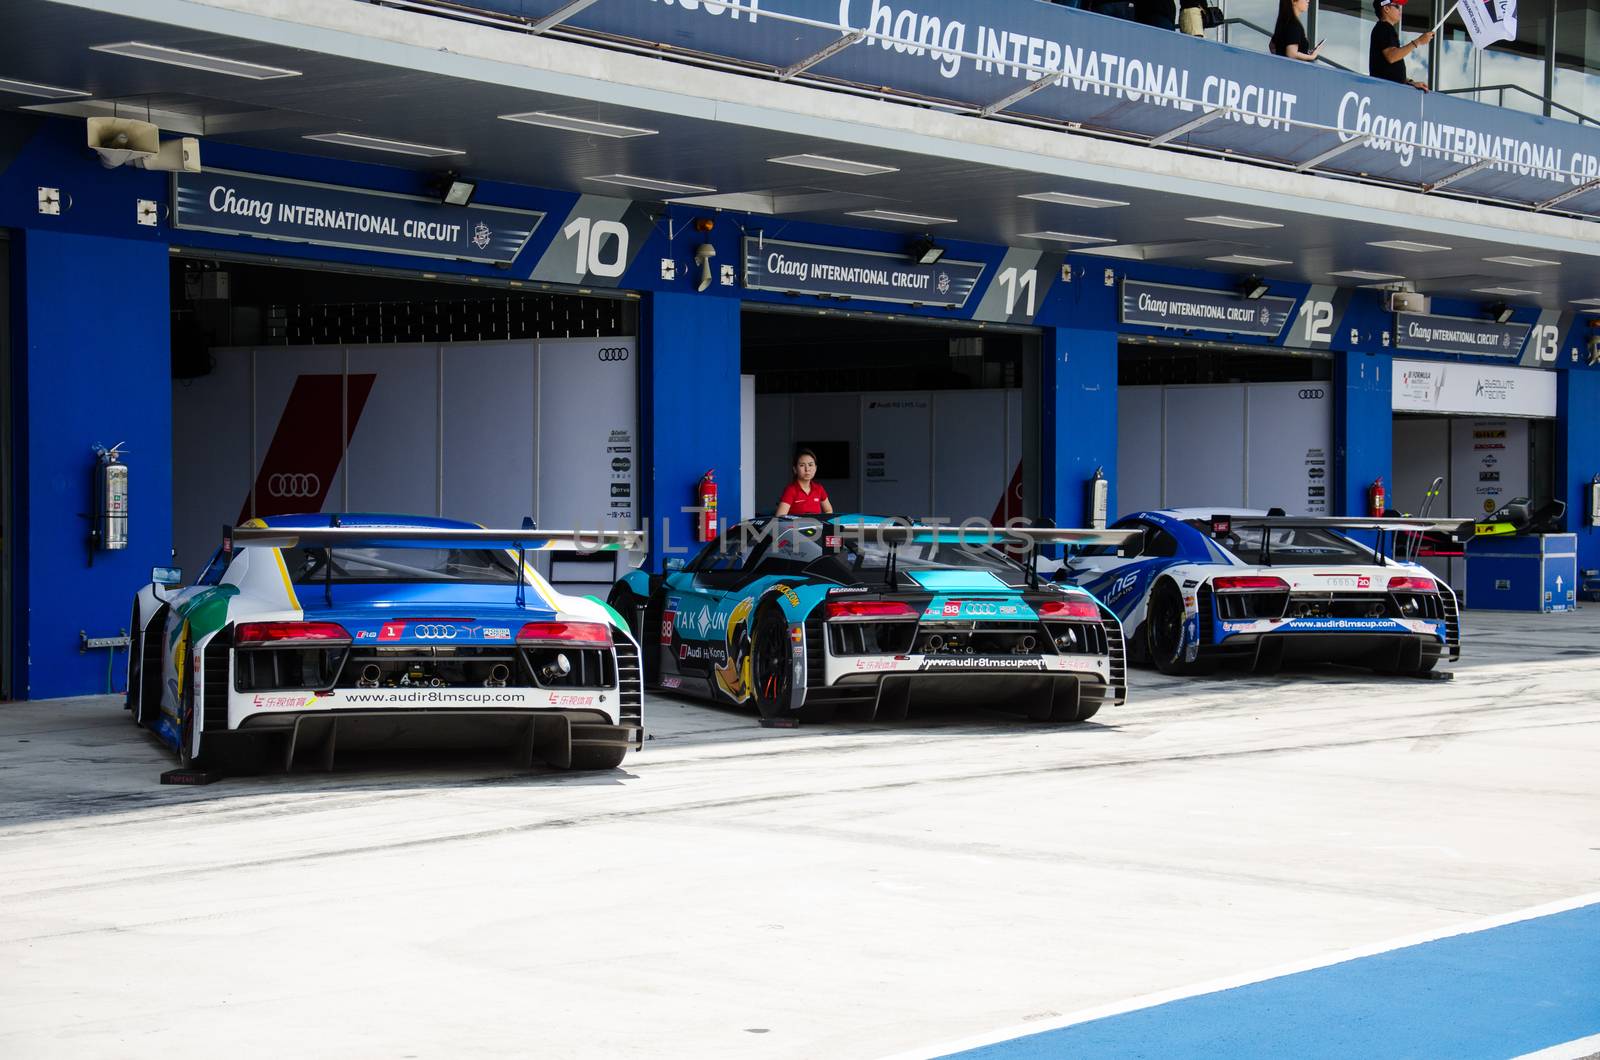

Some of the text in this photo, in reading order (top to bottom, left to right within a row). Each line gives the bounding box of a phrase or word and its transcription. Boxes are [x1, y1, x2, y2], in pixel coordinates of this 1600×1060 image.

[838, 0, 1298, 132] Chang INTERNATIONAL CIRCUIT
[1336, 91, 1417, 167] Chang
[1421, 120, 1565, 184] INTERNATIONAL
[208, 185, 460, 243] Chang INTERNATIONAL CIRCUIT
[564, 217, 629, 278] 10
[767, 252, 930, 289] Chang INTERNATIONAL CIRCUIT
[998, 267, 1037, 317] 11
[1138, 293, 1255, 322] Chang INTERNATIONAL CIRCUIT
[1300, 300, 1334, 343] 12
[1408, 321, 1499, 346] Chang INTERNATIONAL CIRCUIT
[1531, 324, 1559, 362] 13
[676, 610, 696, 629] TAK
[943, 604, 959, 613] 88
[386, 626, 396, 637] 1
[661, 619, 673, 637] 88
[687, 645, 702, 658] Audi
[709, 646, 726, 661] Kong
[345, 691, 526, 705] www.audir8lmscup.com
